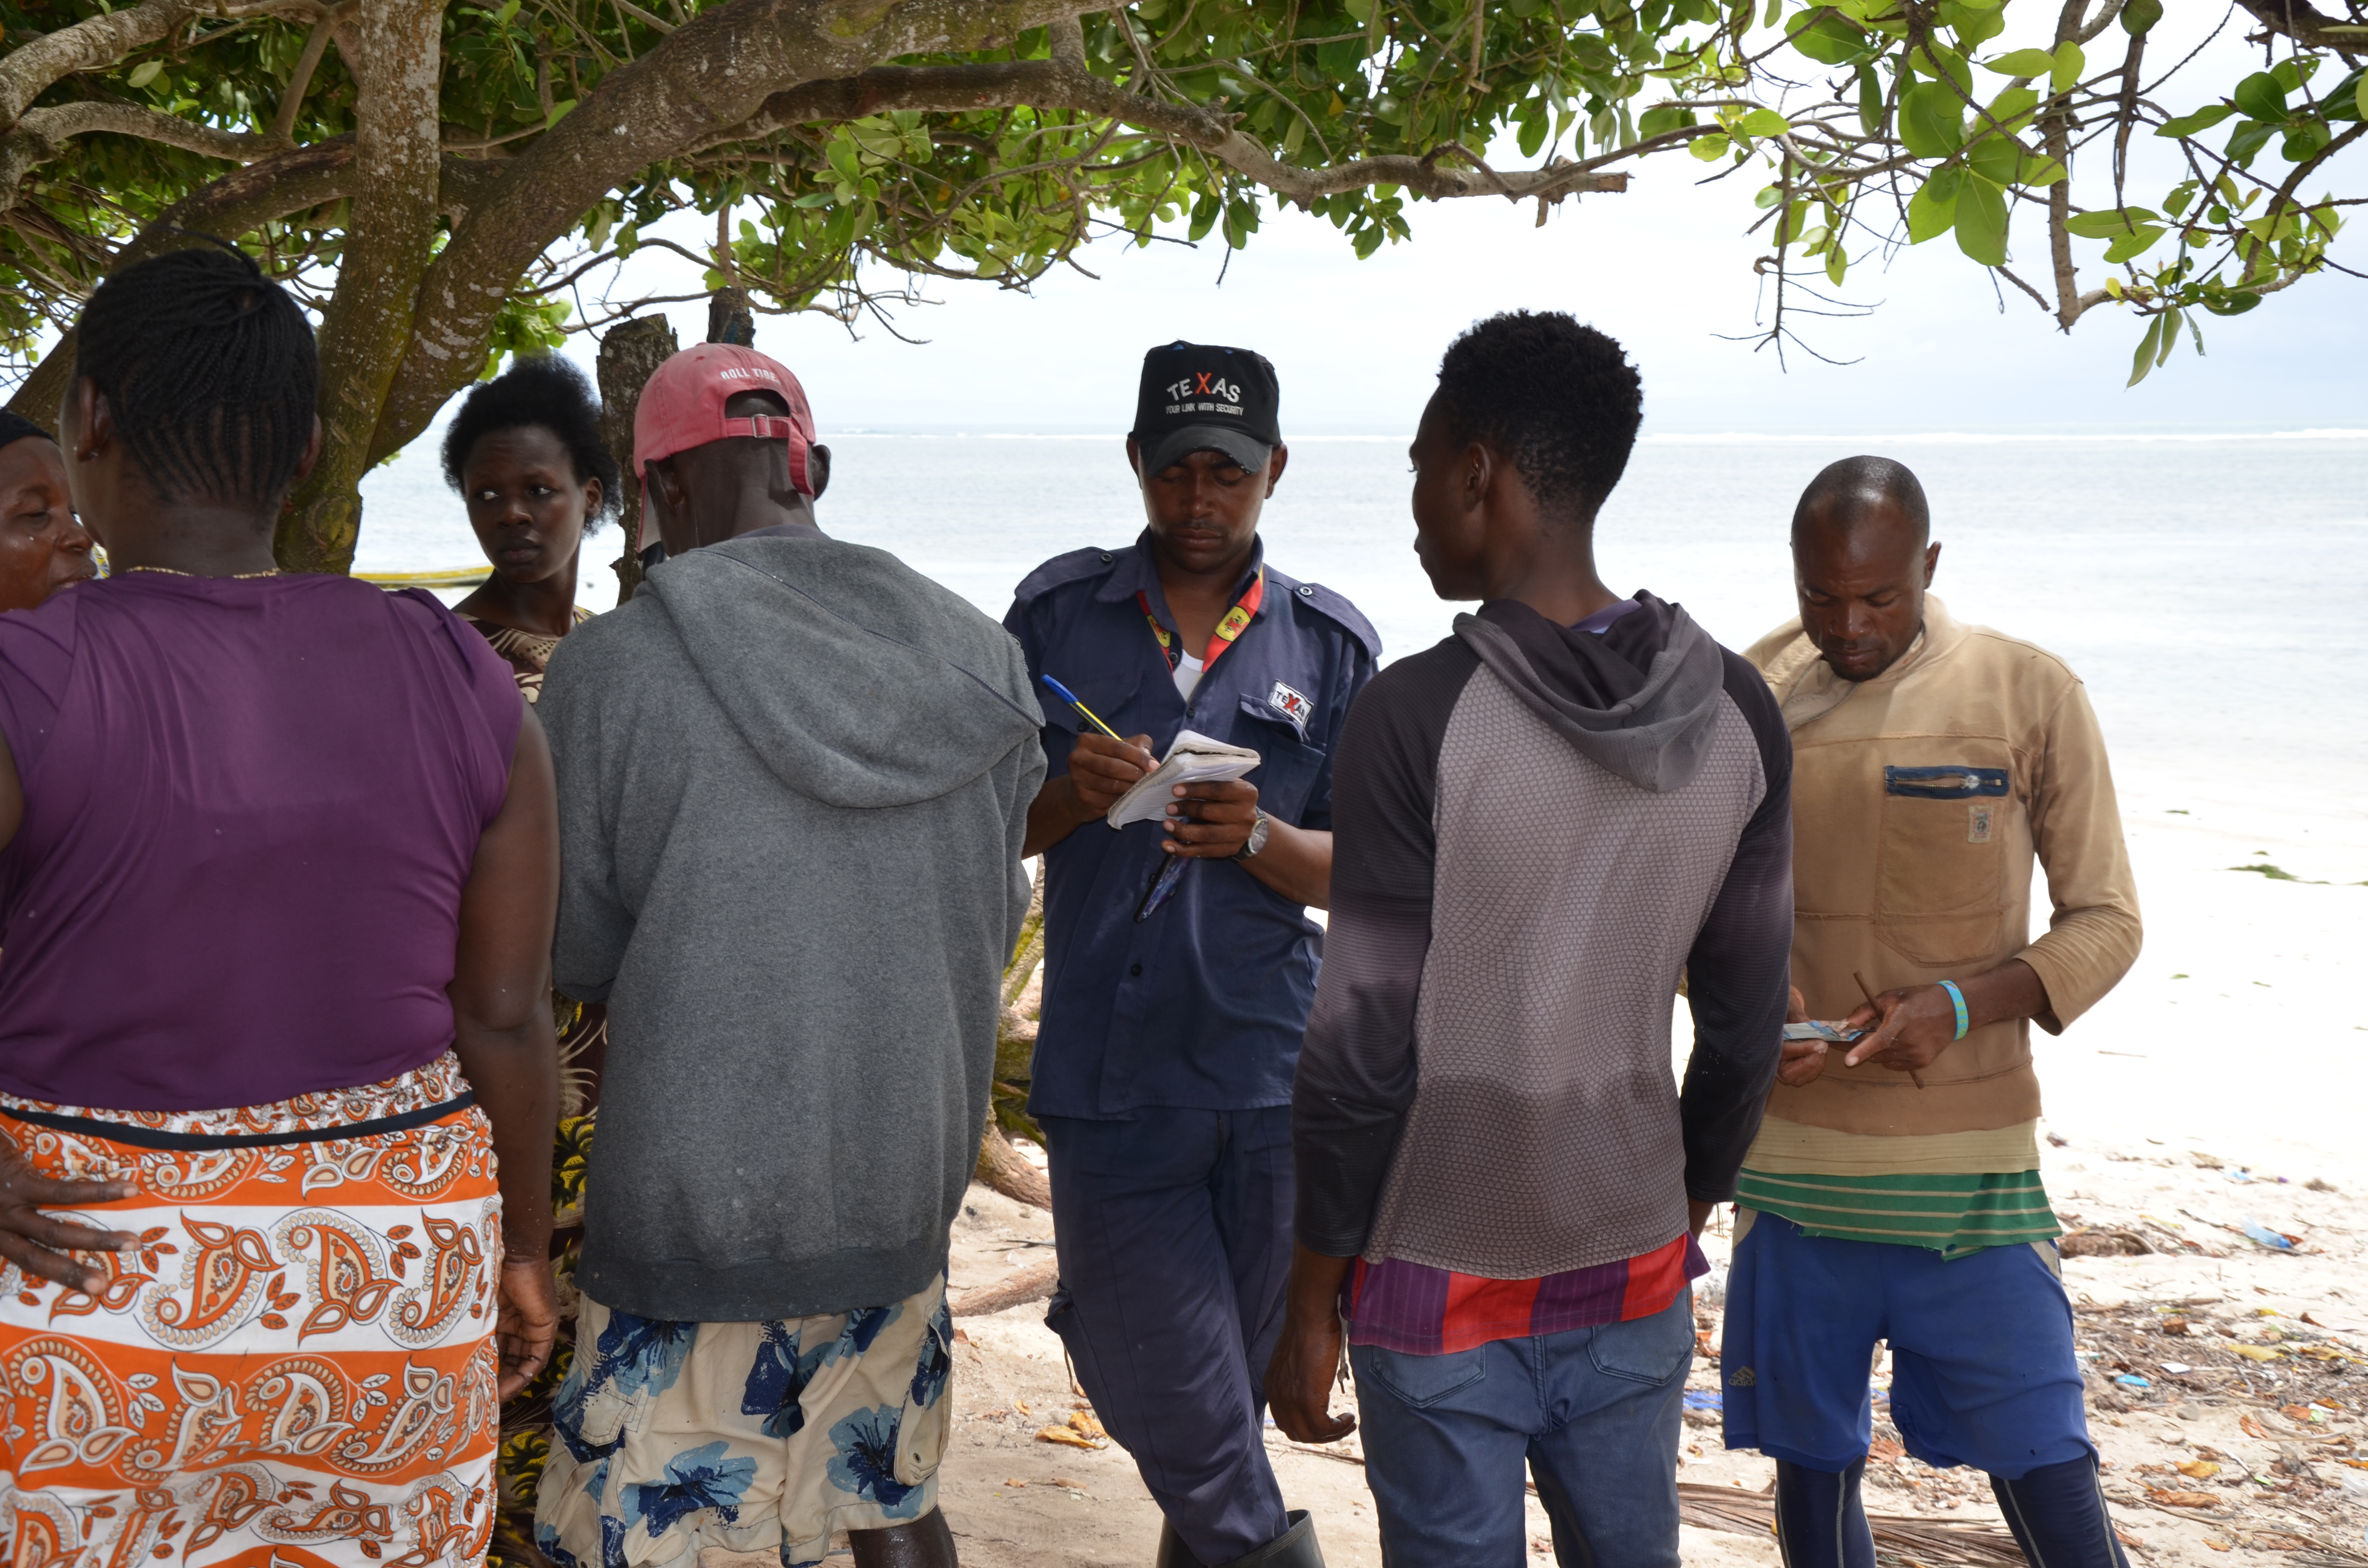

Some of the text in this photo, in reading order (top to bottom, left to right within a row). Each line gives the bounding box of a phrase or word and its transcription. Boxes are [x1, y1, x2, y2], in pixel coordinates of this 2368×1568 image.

[720, 368, 775, 381] ROLL TIDE
[1167, 372, 1241, 403] TEXAS
[1166, 403, 1244, 416] YOUR LINK WITH SECURITY
